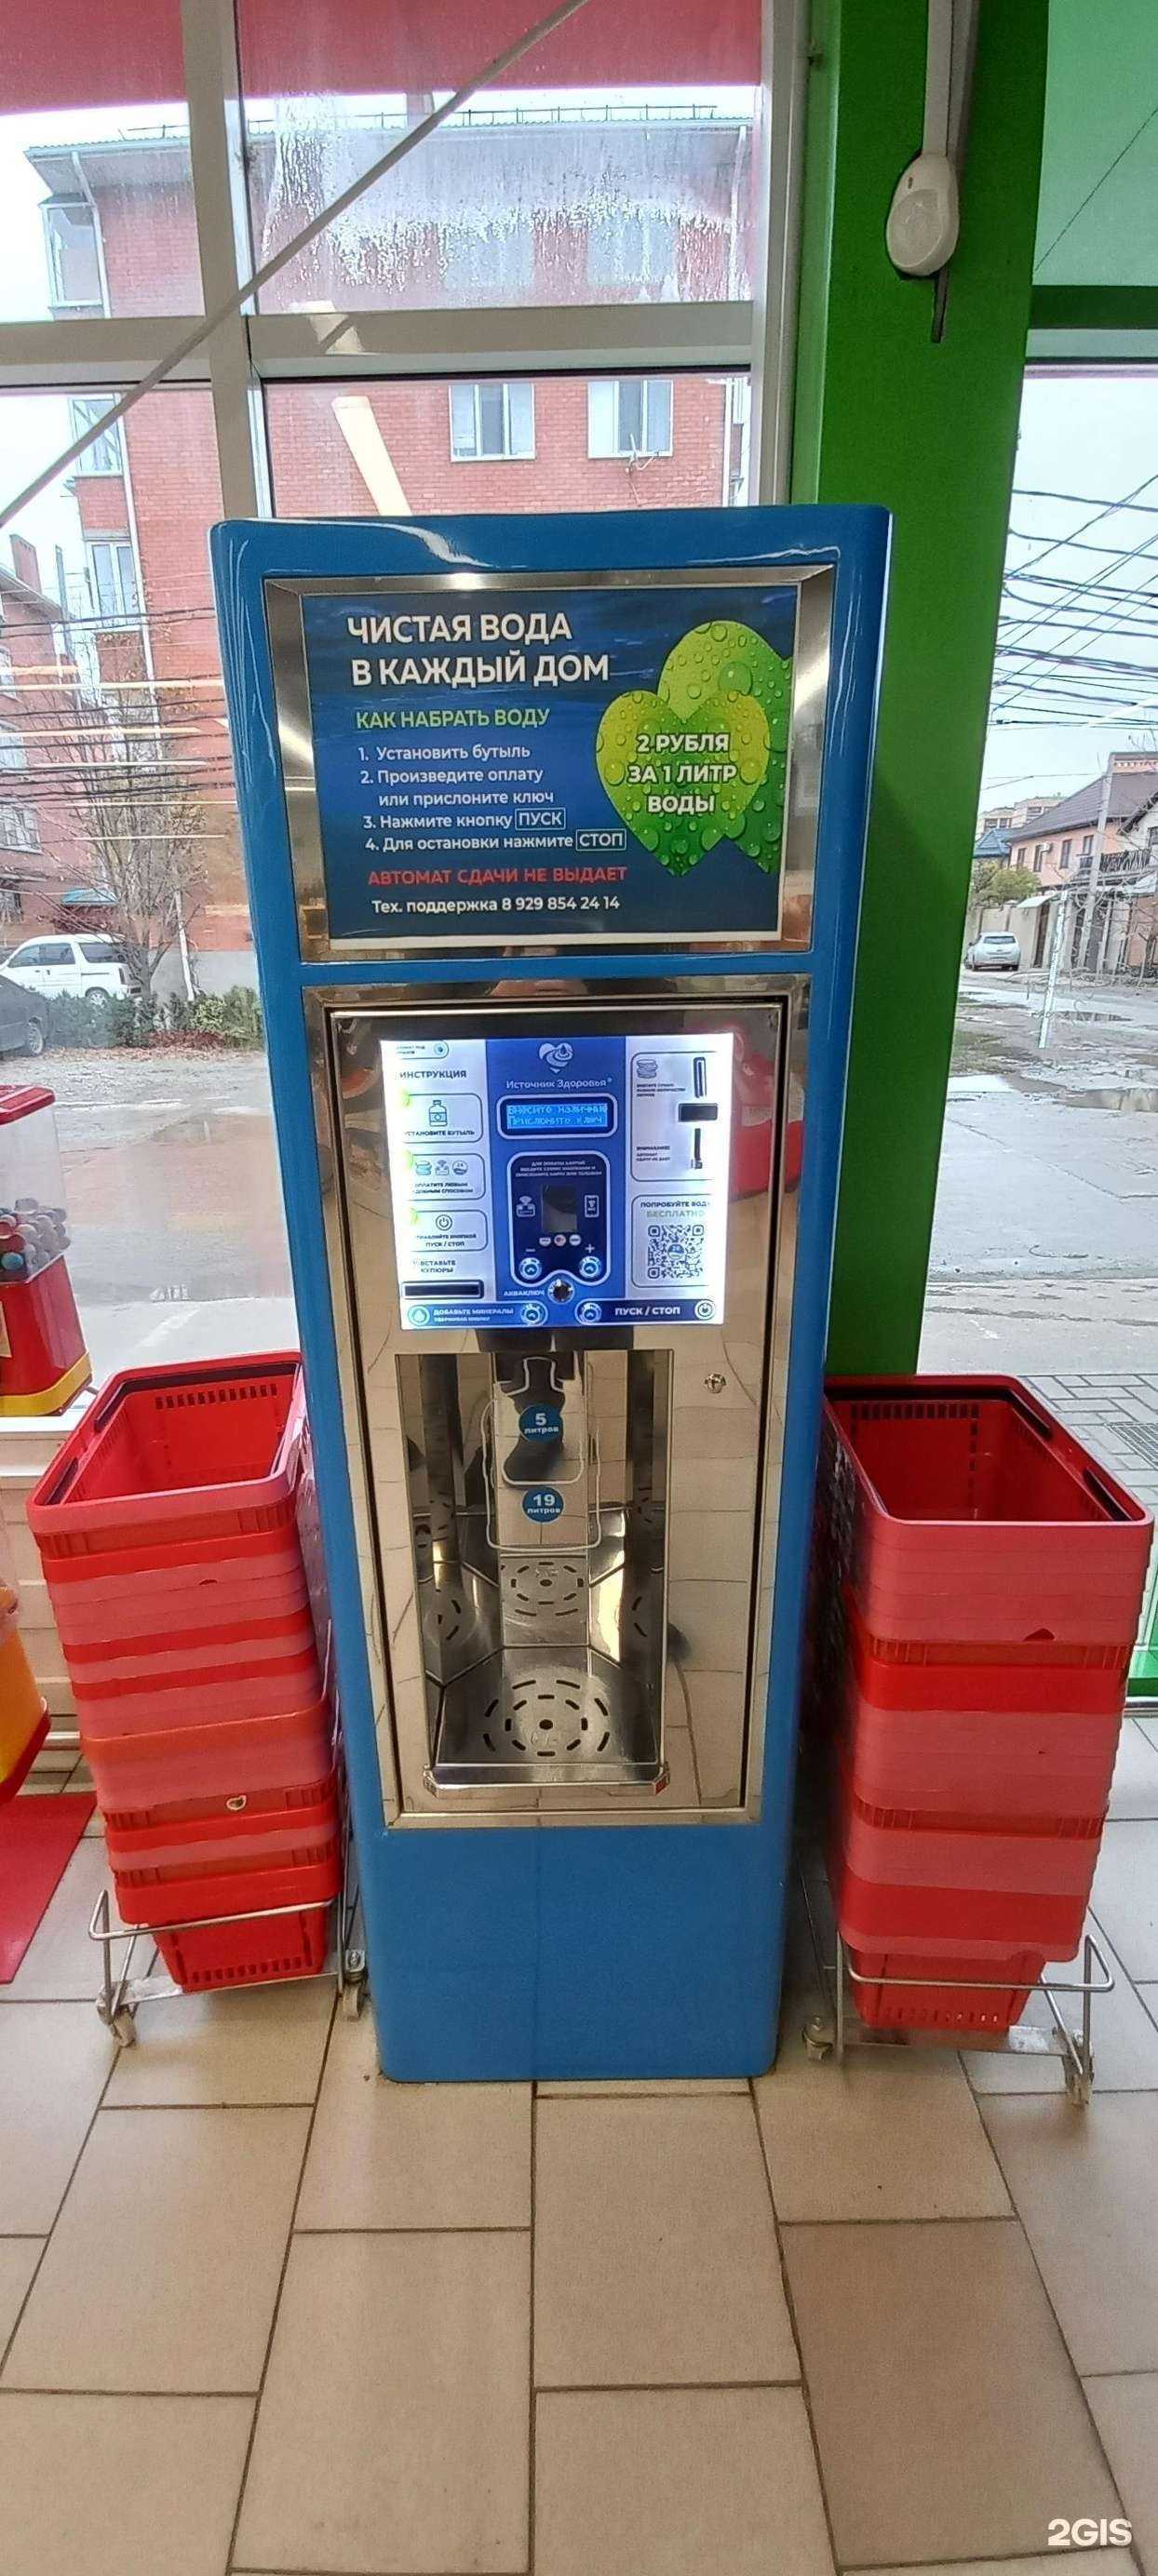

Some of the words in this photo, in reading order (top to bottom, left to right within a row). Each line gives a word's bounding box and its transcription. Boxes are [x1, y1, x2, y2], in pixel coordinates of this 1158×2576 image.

[347, 614, 472, 644] ЧИСТАЯ
[480, 612, 572, 645] ВОДА
[352, 659, 372, 686] В
[379, 650, 526, 689] КАЖДЫЙ
[533, 654, 609, 687] ДОМ
[356, 711, 397, 730] КАК
[400, 709, 490, 728] НАБРАТЬ
[494, 707, 550, 728] ВОДУ
[637, 735, 650, 753] 2
[655, 733, 729, 753] РУБЛЯ
[358, 748, 370, 761] 1.
[376, 745, 468, 761] Установить
[472, 746, 531, 760] бутыль
[360, 771, 373, 784] 2.
[377, 769, 484, 786] Произведите
[488, 770, 544, 785] оплату
[628, 764, 657, 784] ЗА
[663, 765, 671, 782] 1
[677, 764, 737, 783] ЛИТР
[378, 796, 410, 807] или
[412, 792, 508, 810] прислоните
[512, 790, 554, 804] ключ
[648, 796, 715, 814] ВОДЫ
[363, 816, 376, 829] 3.
[380, 813, 452, 829] Нажмите
[456, 812, 512, 830] кнопку
[518, 811, 563, 827] ПУСК
[365, 838, 380, 851] 4.
[383, 836, 413, 852] Для
[417, 838, 499, 851] остановки
[504, 836, 573, 849] нажмите
[579, 832, 624, 848] СТОП
[368, 868, 451, 886] АВТОМАТ
[457, 867, 519, 886] СДАЧИ
[524, 867, 547, 883] НЕ
[553, 866, 627, 883] ВЫДАЕТ
[372, 898, 402, 914] Тех.
[406, 899, 498, 916] поддержка
[502, 896, 512, 911] 8
[516, 896, 543, 911] 929
[547, 895, 576, 911] 854
[580, 895, 599, 910] 24
[603, 894, 620, 910] 14
[399, 1070, 467, 1080] ИНСТРУКЦИЯ
[506, 1080, 556, 1089] Источник
[558, 1079, 607, 1090] Здоровья
[614, 1307, 642, 1316] ПУСК
[652, 1306, 681, 1316] СТОП
[535, 1413, 546, 1426] 5
[532, 1494, 556, 1507] 19
